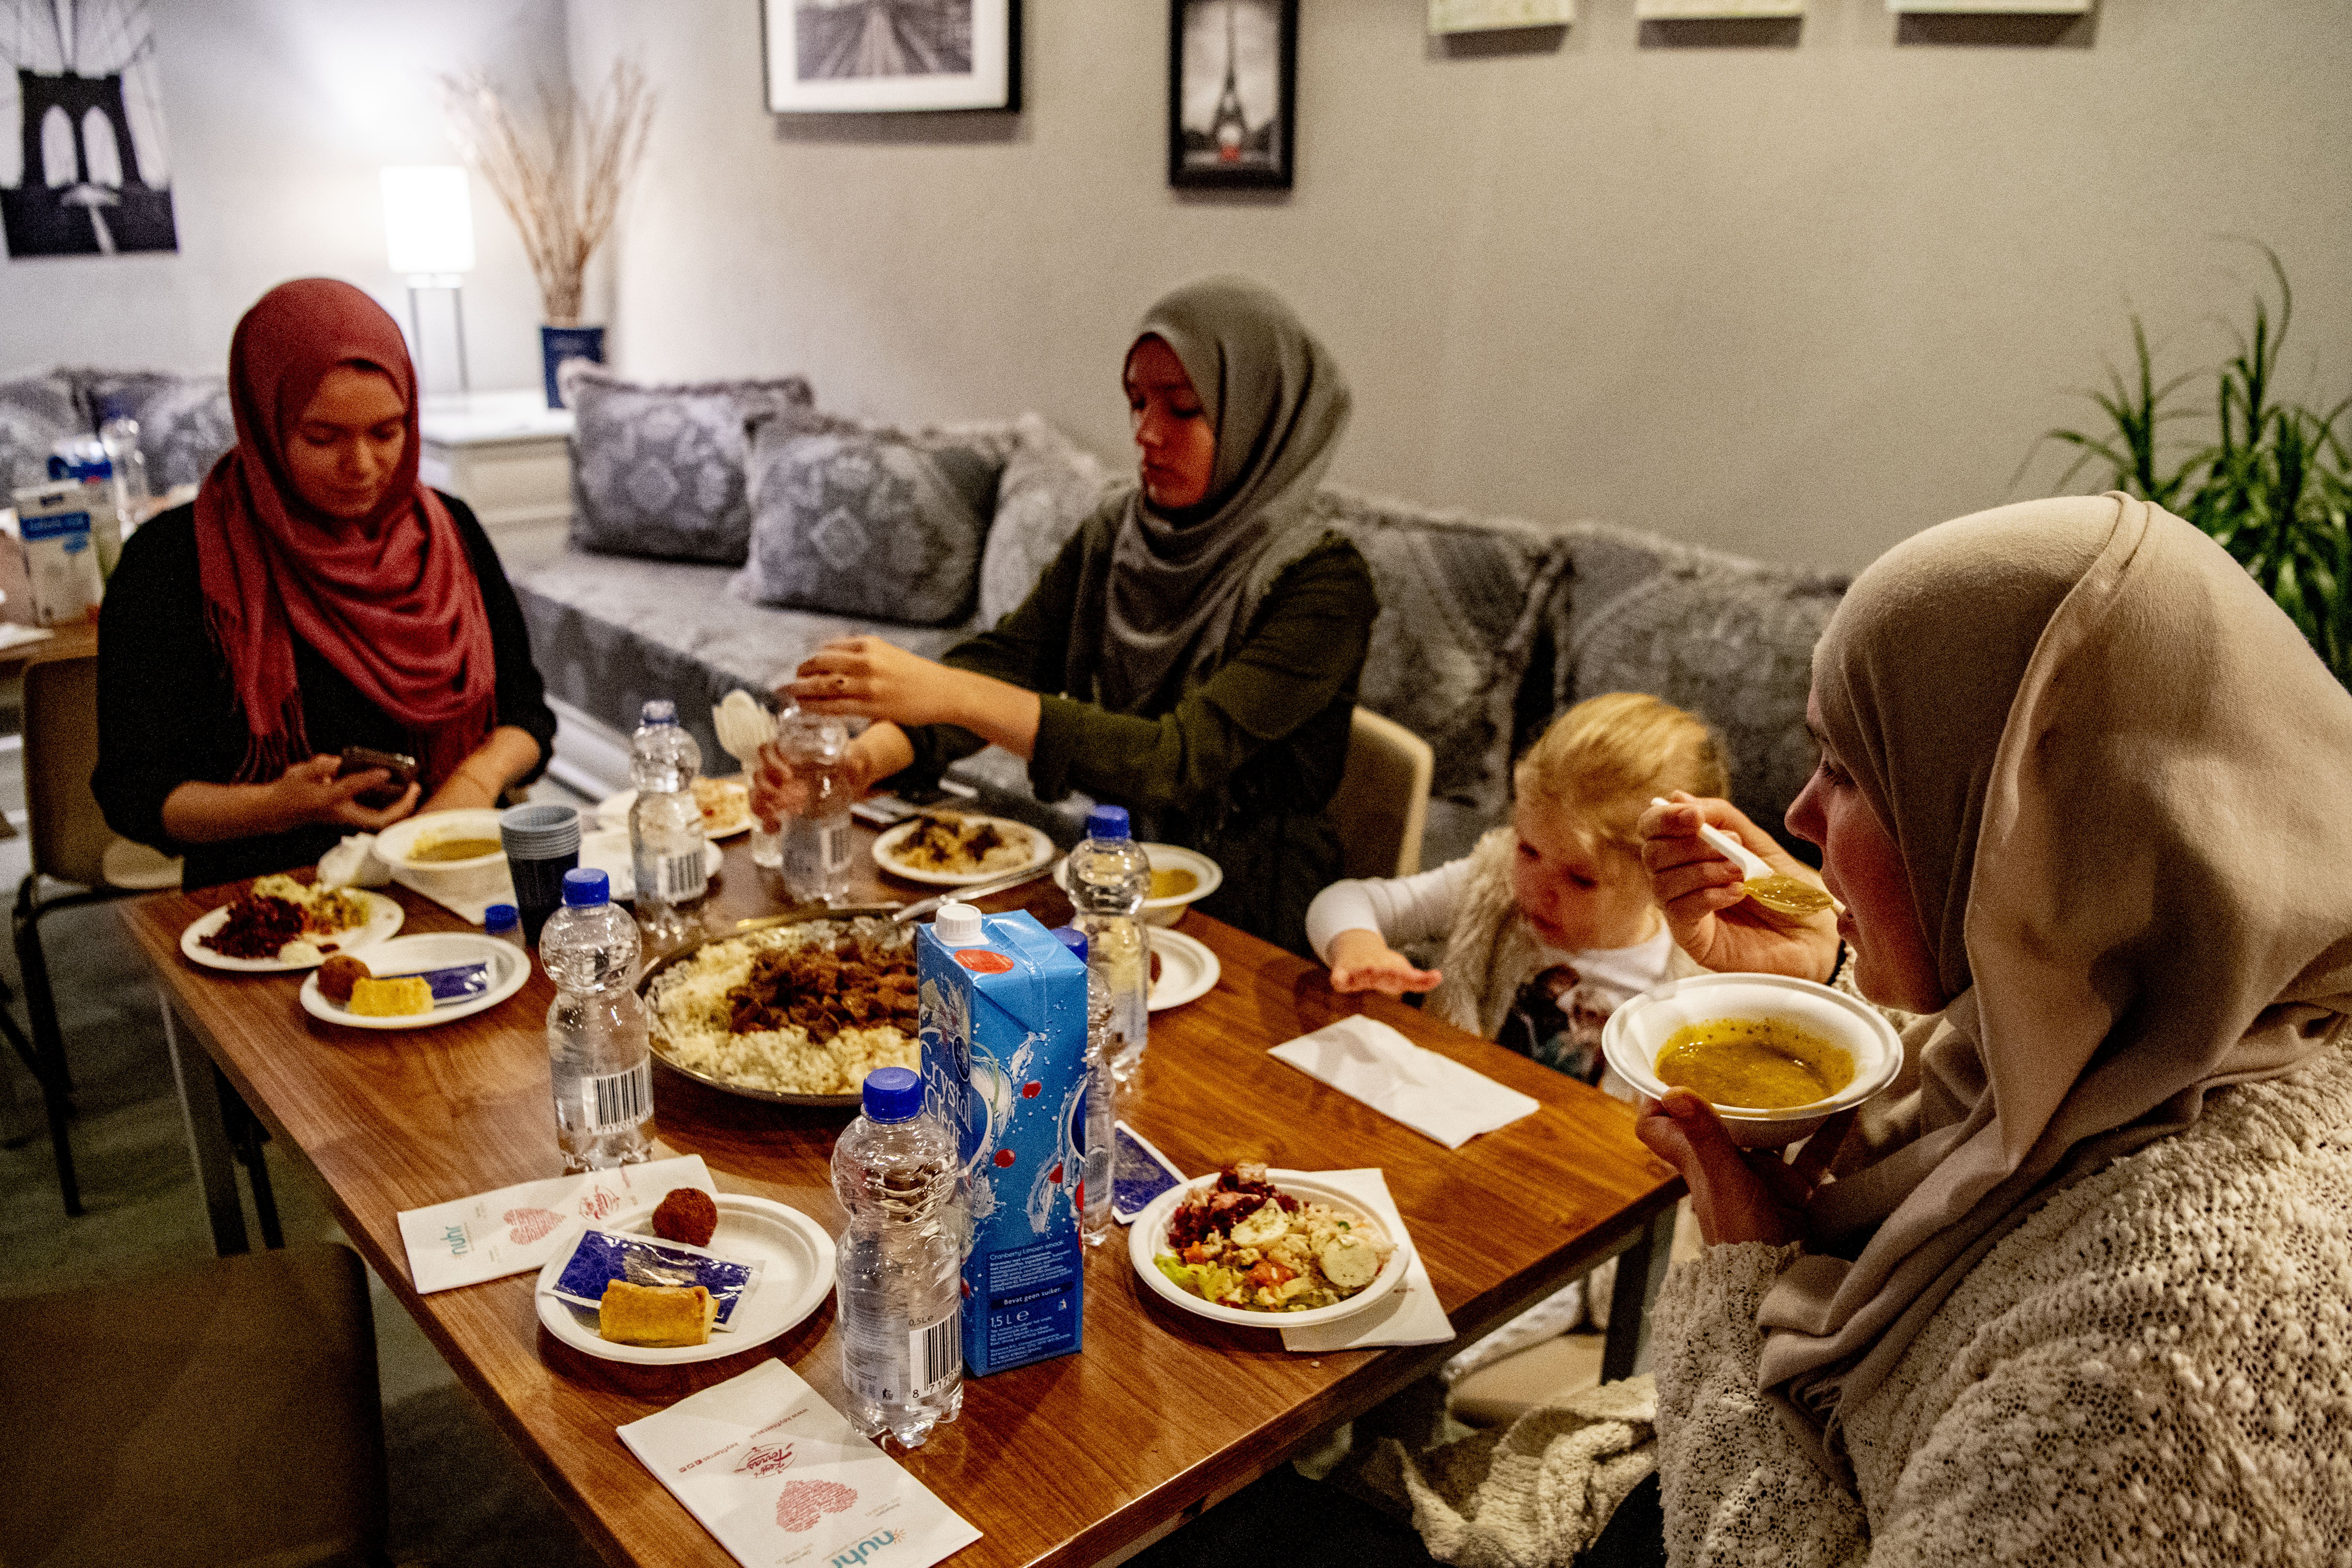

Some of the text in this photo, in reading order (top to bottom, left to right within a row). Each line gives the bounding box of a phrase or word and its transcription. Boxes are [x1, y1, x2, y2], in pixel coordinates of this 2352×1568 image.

[920, 1040, 972, 1134] Crystal
[925, 1084, 961, 1150] Clear
[441, 1226, 468, 1255] nuhr
[990, 1251, 1022, 1261] Cranberry
[1004, 1297, 1022, 1305] Bevat
[1024, 1293, 1040, 1302] geen
[991, 1315, 1003, 1328] 1,5
[1006, 1314, 1012, 1325] L
[912, 1389, 919, 1398] 8
[750, 1408, 809, 1439] www.keyfiterras.nl
[703, 1442, 740, 1461] keyfiterras
[747, 1448, 793, 1469] Terras
